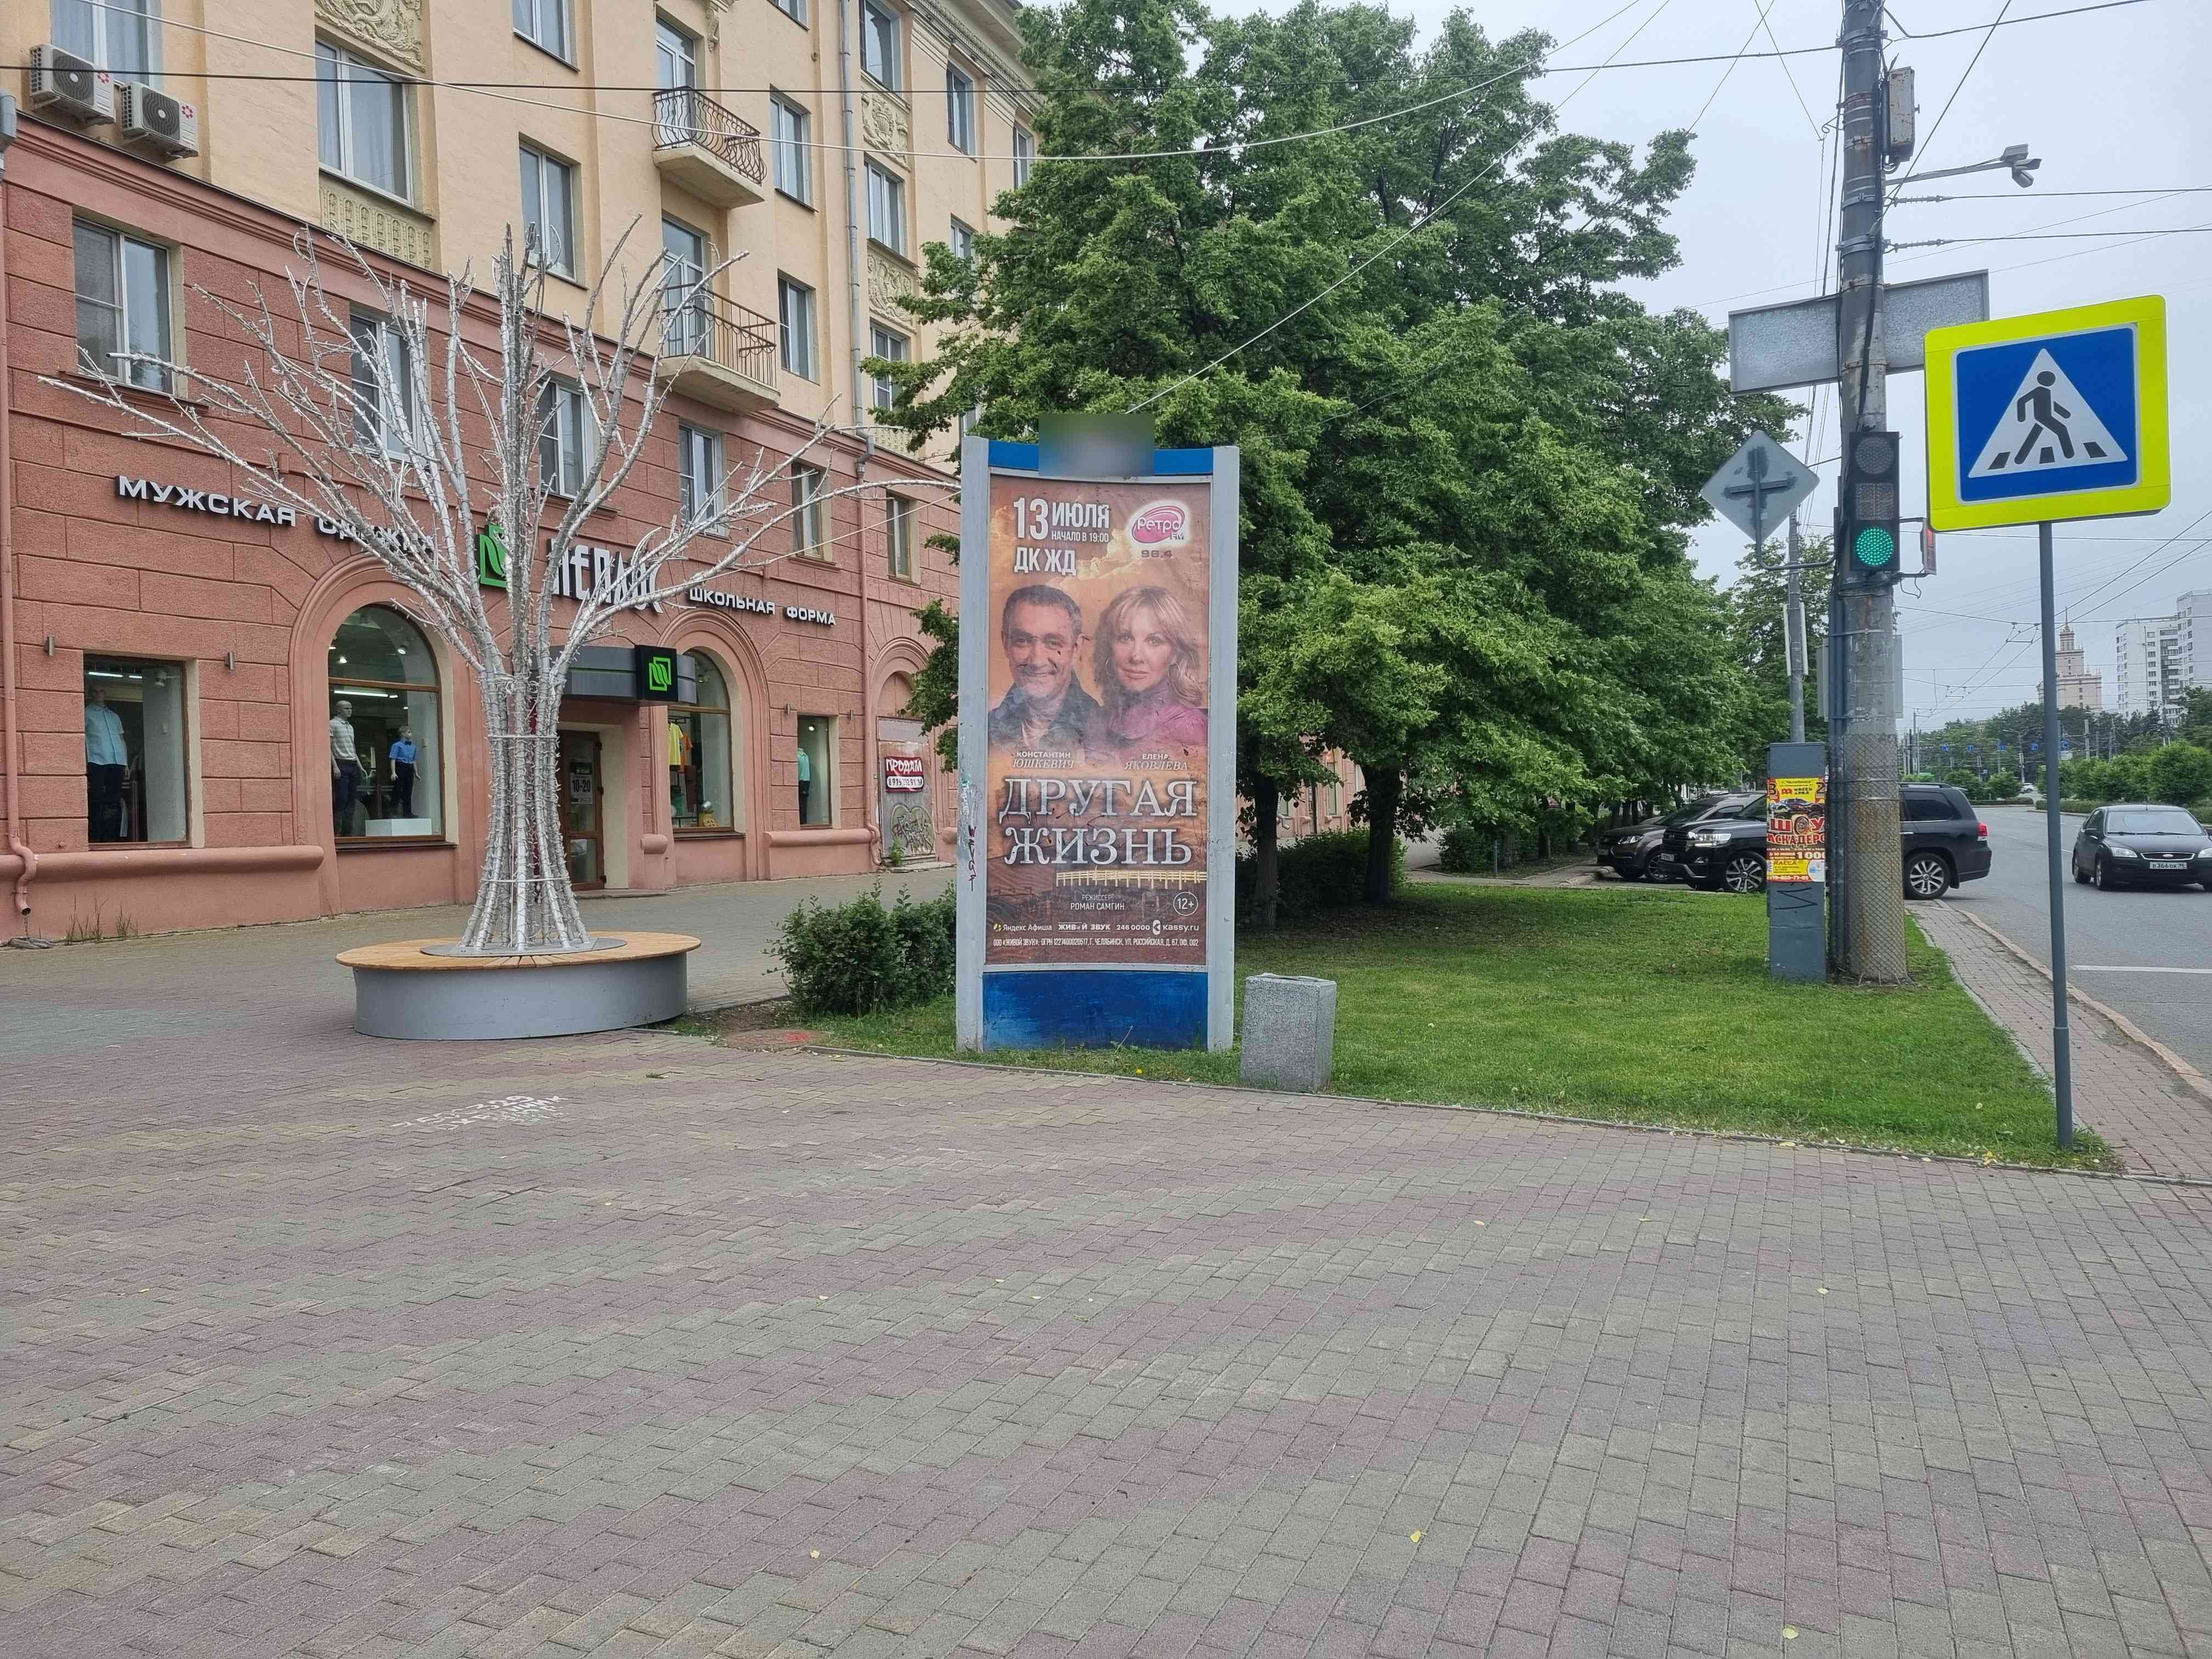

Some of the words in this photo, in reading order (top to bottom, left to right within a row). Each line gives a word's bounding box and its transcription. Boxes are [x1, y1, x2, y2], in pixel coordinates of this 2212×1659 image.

[119, 475, 296, 527] МУЖСКАЯ
[1013, 497, 1049, 540] 13
[1052, 501, 1109, 529] ИЮЛЯ
[1051, 531, 1081, 541] НАЧАЛО
[1082, 532, 1087, 542] В
[1089, 532, 1109, 543] 19:00
[1141, 550, 1173, 558] 96.4
[1014, 547, 1041, 573] ДК
[1043, 548, 1076, 575] ЖД
[689, 587, 776, 615] ШКОЛЬНАЯ
[786, 606, 837, 626] ФОРМА
[886, 759, 923, 775] ПРОДАМ
[1012, 758, 1075, 769] ЮШКЕВИЧ
[1124, 760, 1189, 770] ЯКОВЛЕВА
[572, 779, 591, 793] 10-20
[998, 777, 1198, 825] ДРУГАЯ
[1004, 827, 1192, 865] ЖИЗНЬ
[1070, 902, 1094, 911] РОМАН
[1096, 902, 1125, 911] САМГИН
[1177, 898, 1195, 910] 12+
[1028, 923, 1052, 932] Афиша
[1163, 924, 1199, 933] kassy.ru
